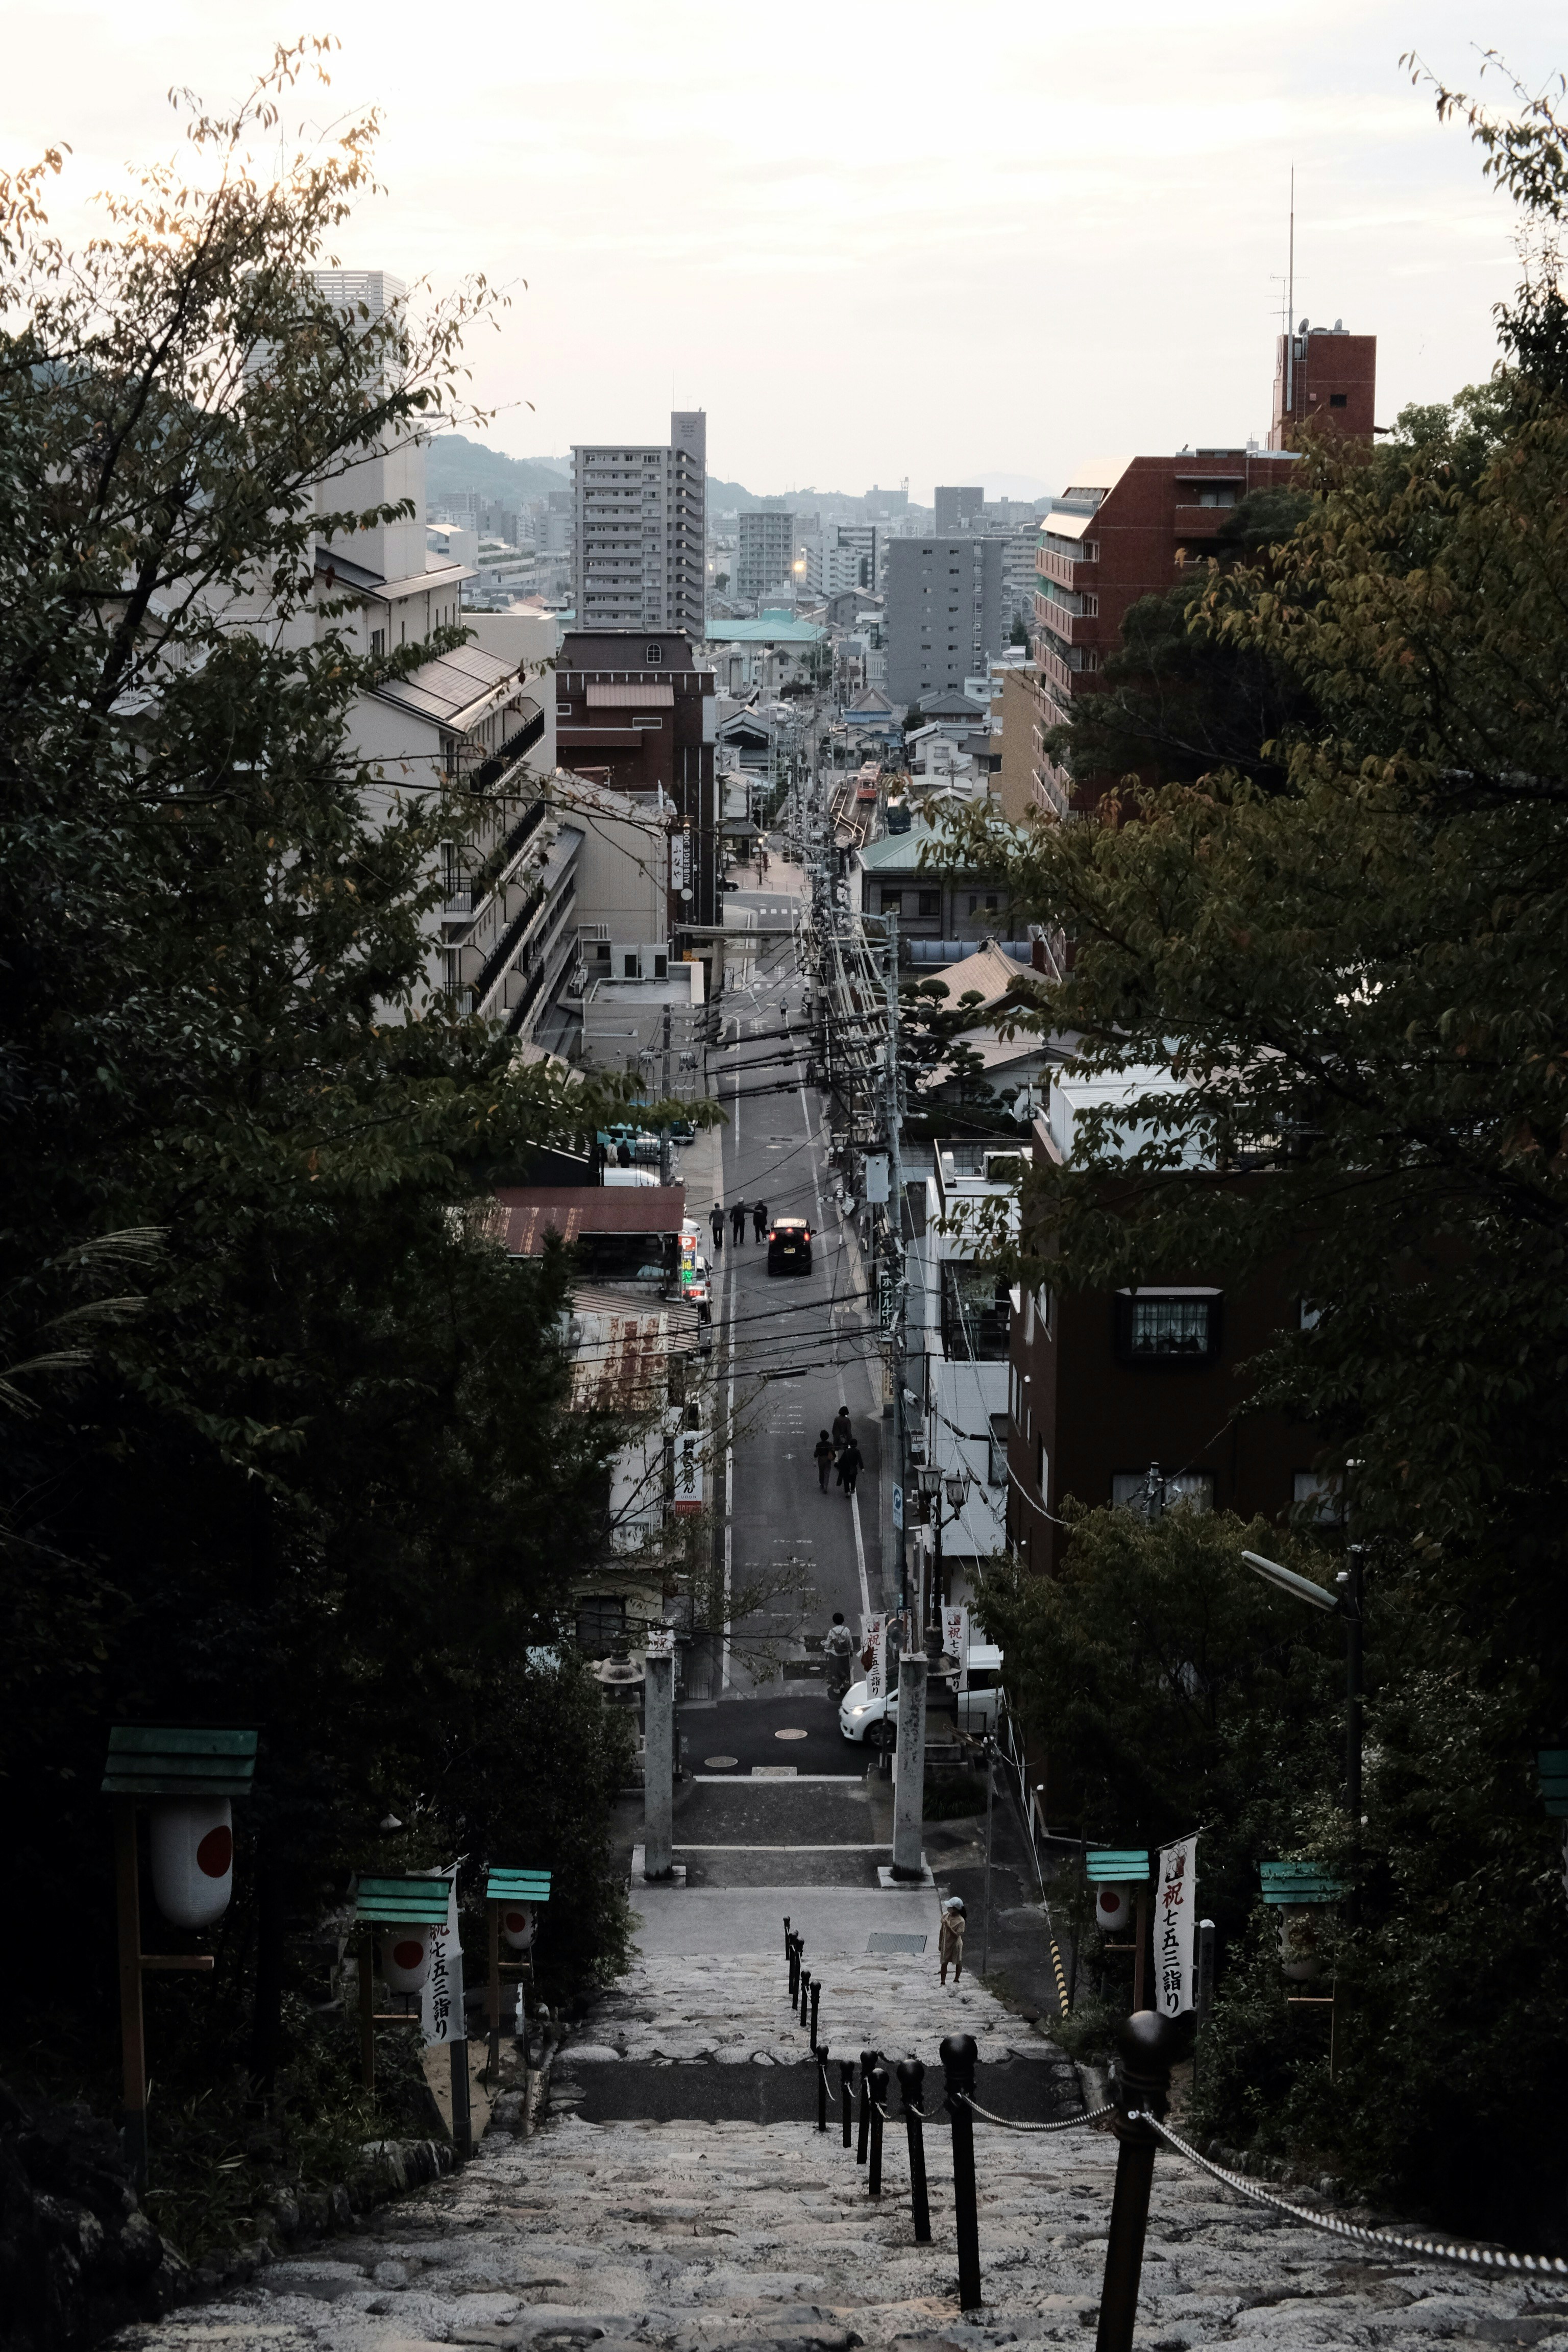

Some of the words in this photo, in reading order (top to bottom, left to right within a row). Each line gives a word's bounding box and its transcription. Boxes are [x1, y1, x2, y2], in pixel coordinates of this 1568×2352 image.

[682, 1238, 692, 1250] P
[683, 1439, 694, 1493] 鍋焼うん
[1162, 1882, 1184, 2013] 祝七五三詣り
